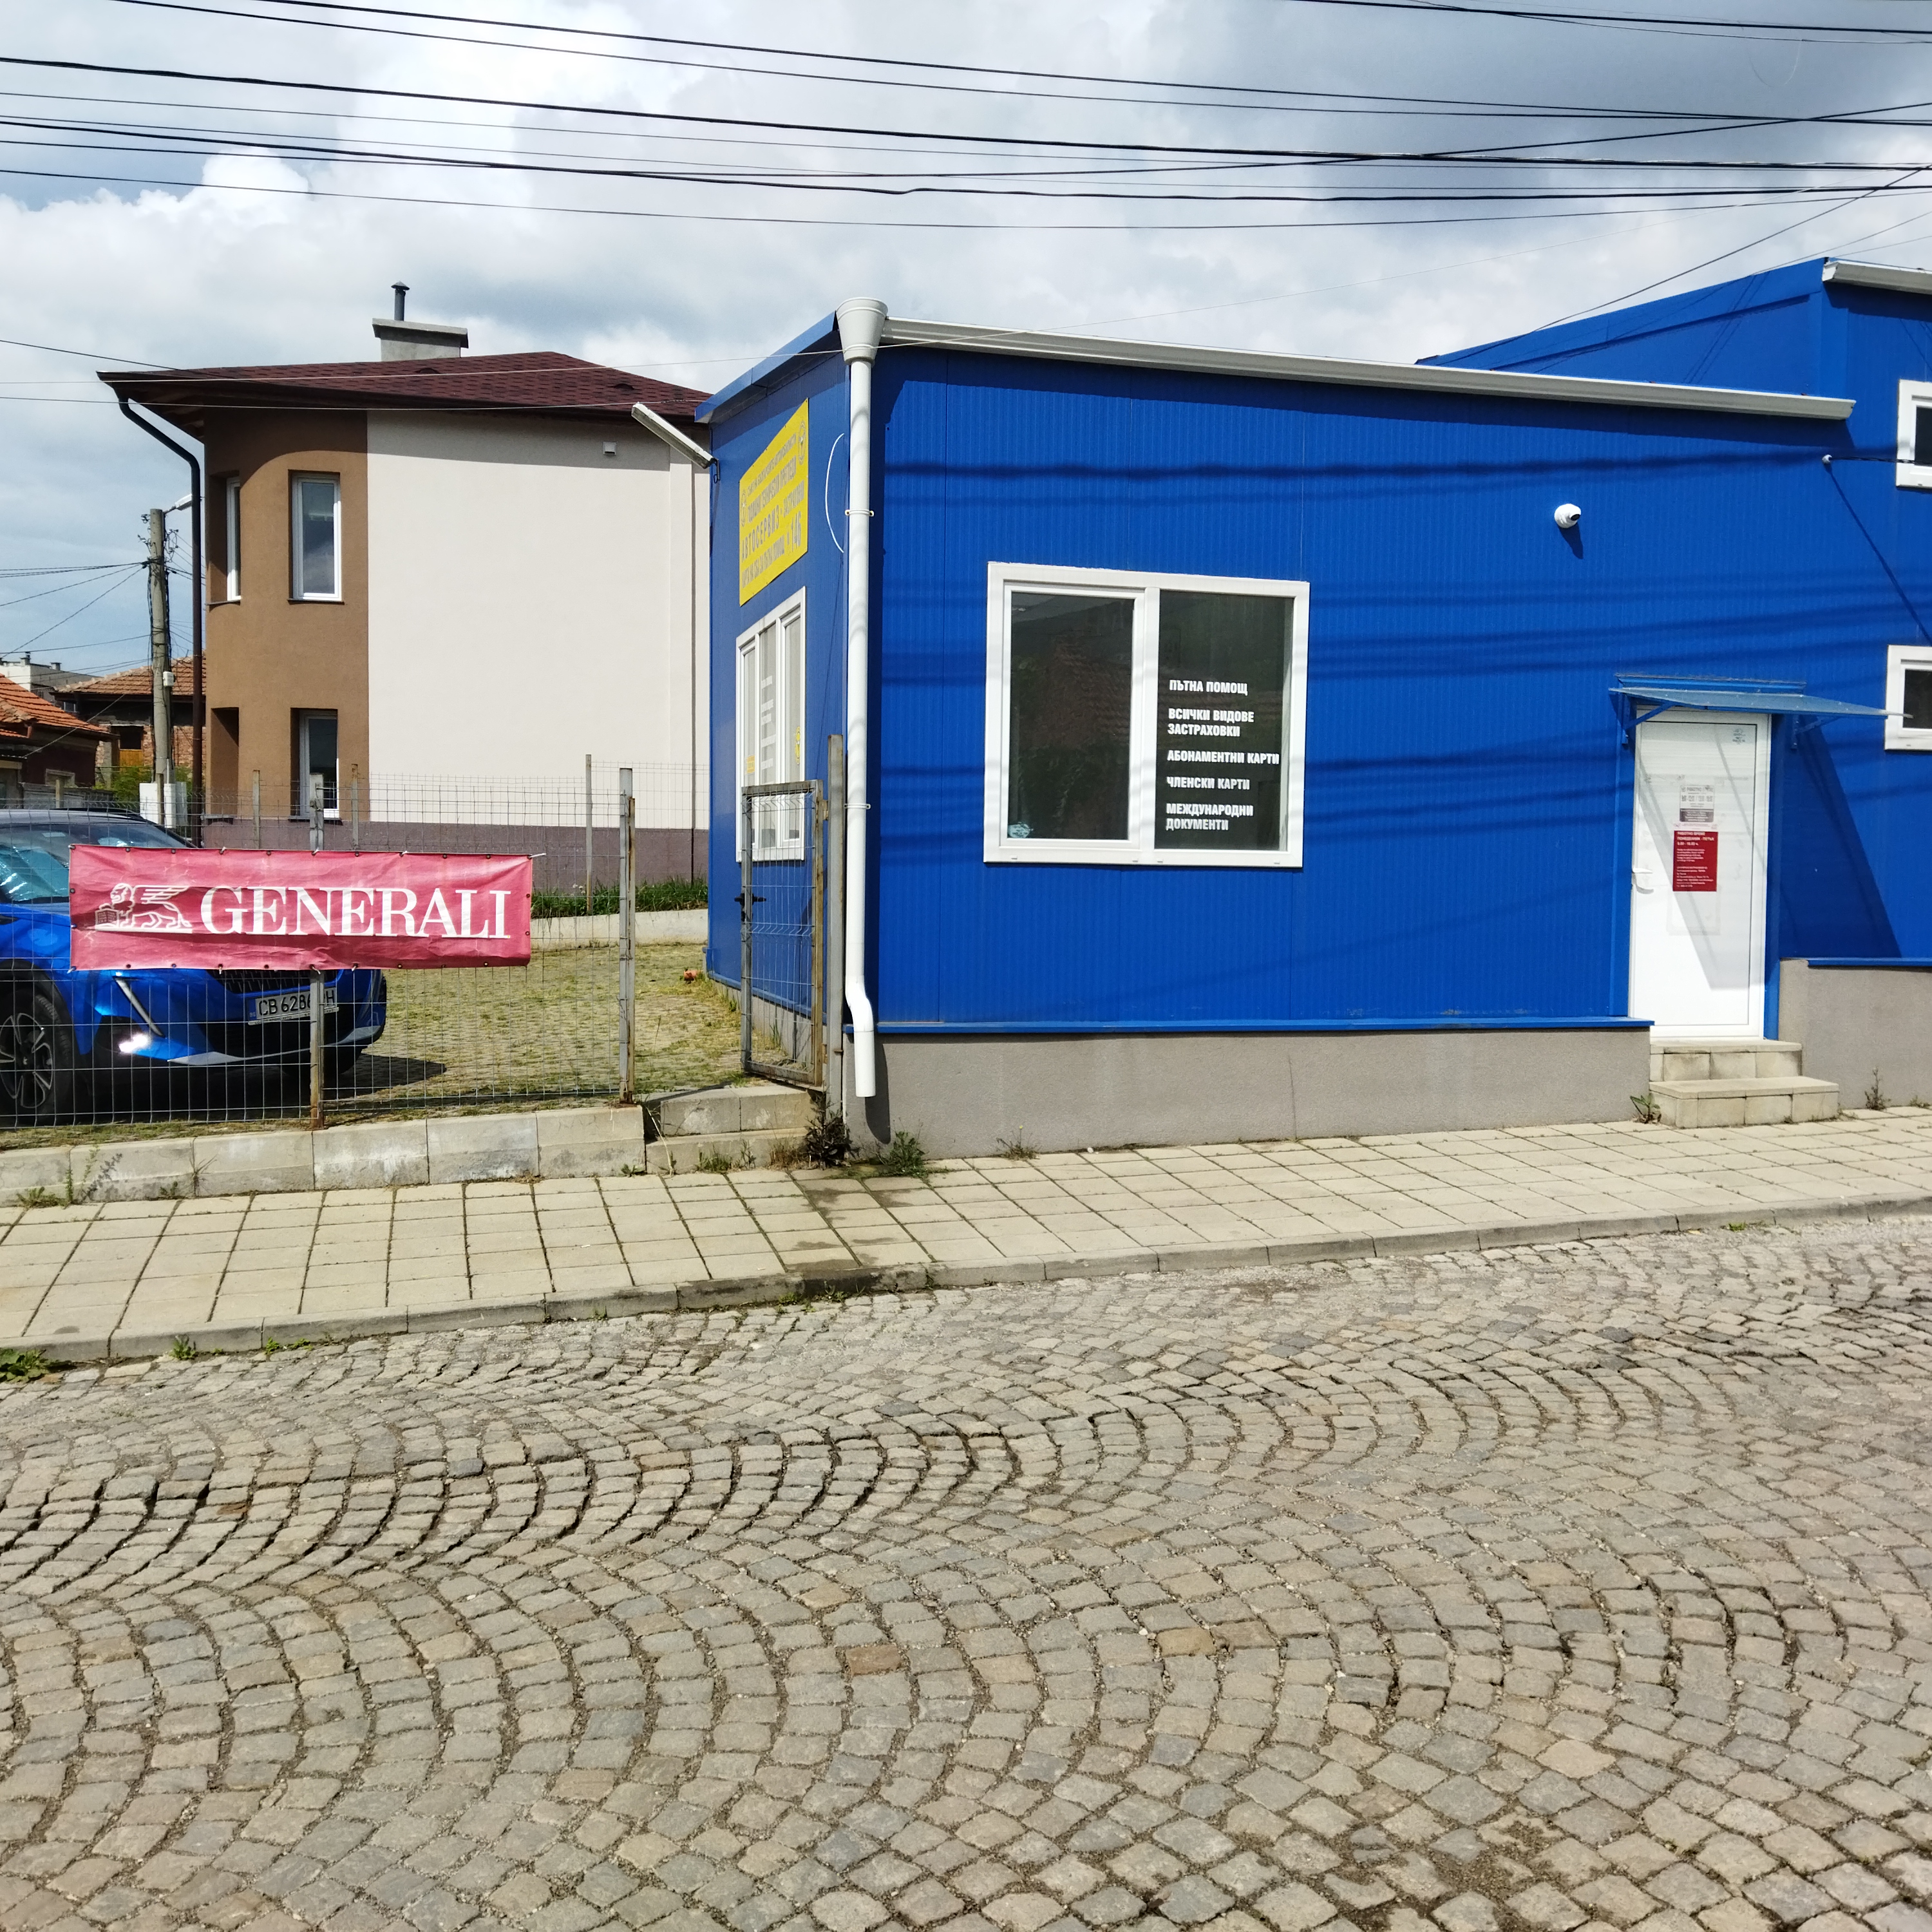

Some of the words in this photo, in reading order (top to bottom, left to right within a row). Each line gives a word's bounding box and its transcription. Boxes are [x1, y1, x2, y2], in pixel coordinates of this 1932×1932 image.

[742, 504, 779, 563] АВТОСЕРВИЗ
[791, 510, 801, 553] 146
[1169, 679, 1204, 692] ПЪТНА
[1206, 681, 1248, 696] ПОМОЩ
[1168, 708, 1211, 721] ВСИЧКИ
[1213, 710, 1255, 724] ВИДОВЕ
[1167, 723, 1240, 737] ЗАСТРАХОВКИ
[1166, 750, 1245, 764] АБОНАМЕНТНИ
[1247, 752, 1280, 764] КАРТИ
[1166, 776, 1215, 789] ЧЛЕНСКИ
[1217, 778, 1250, 790] КАРТИ
[1166, 802, 1254, 817] МЕЖДУНАРОДНИ
[1166, 817, 1229, 831] ДОКУМЕНТИ
[200, 886, 511, 939] GENERALI
[258, 998, 278, 1016] CB
[323, 989, 335, 1006] H
